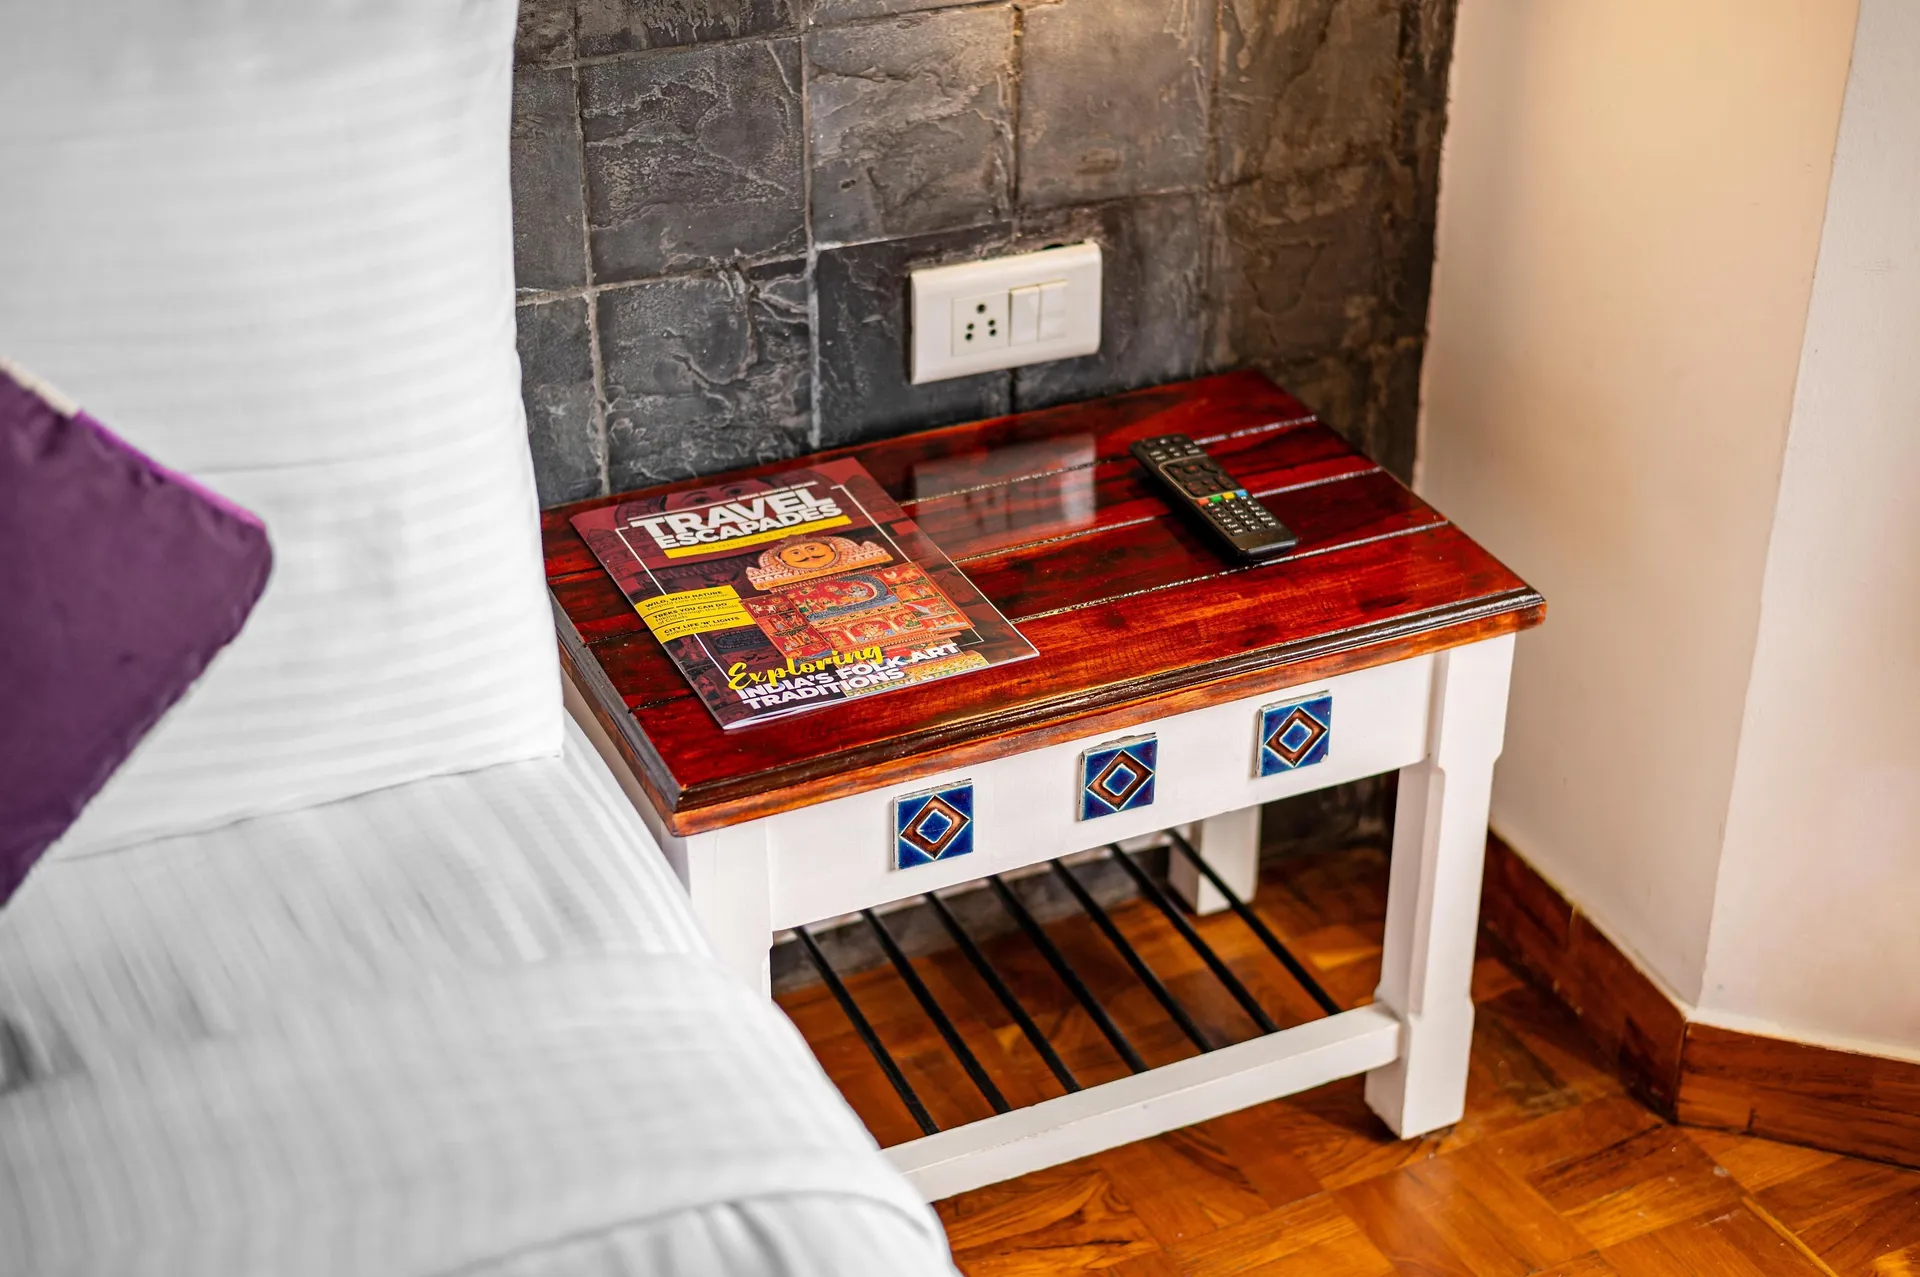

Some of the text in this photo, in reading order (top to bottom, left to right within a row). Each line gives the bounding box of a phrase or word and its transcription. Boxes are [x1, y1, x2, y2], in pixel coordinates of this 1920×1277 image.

[630, 488, 835, 538] TRAVEL
[657, 504, 842, 549] ESCAPADES
[645, 599, 668, 608] WILD,
[653, 610, 678, 619] TREKS
[664, 626, 680, 634] CITY
[712, 616, 740, 624] LIGHTS
[728, 645, 883, 690] Exploring
[739, 643, 958, 701] INDIA'S FOLK ART
[743, 668, 905, 710] TRADITIONS
